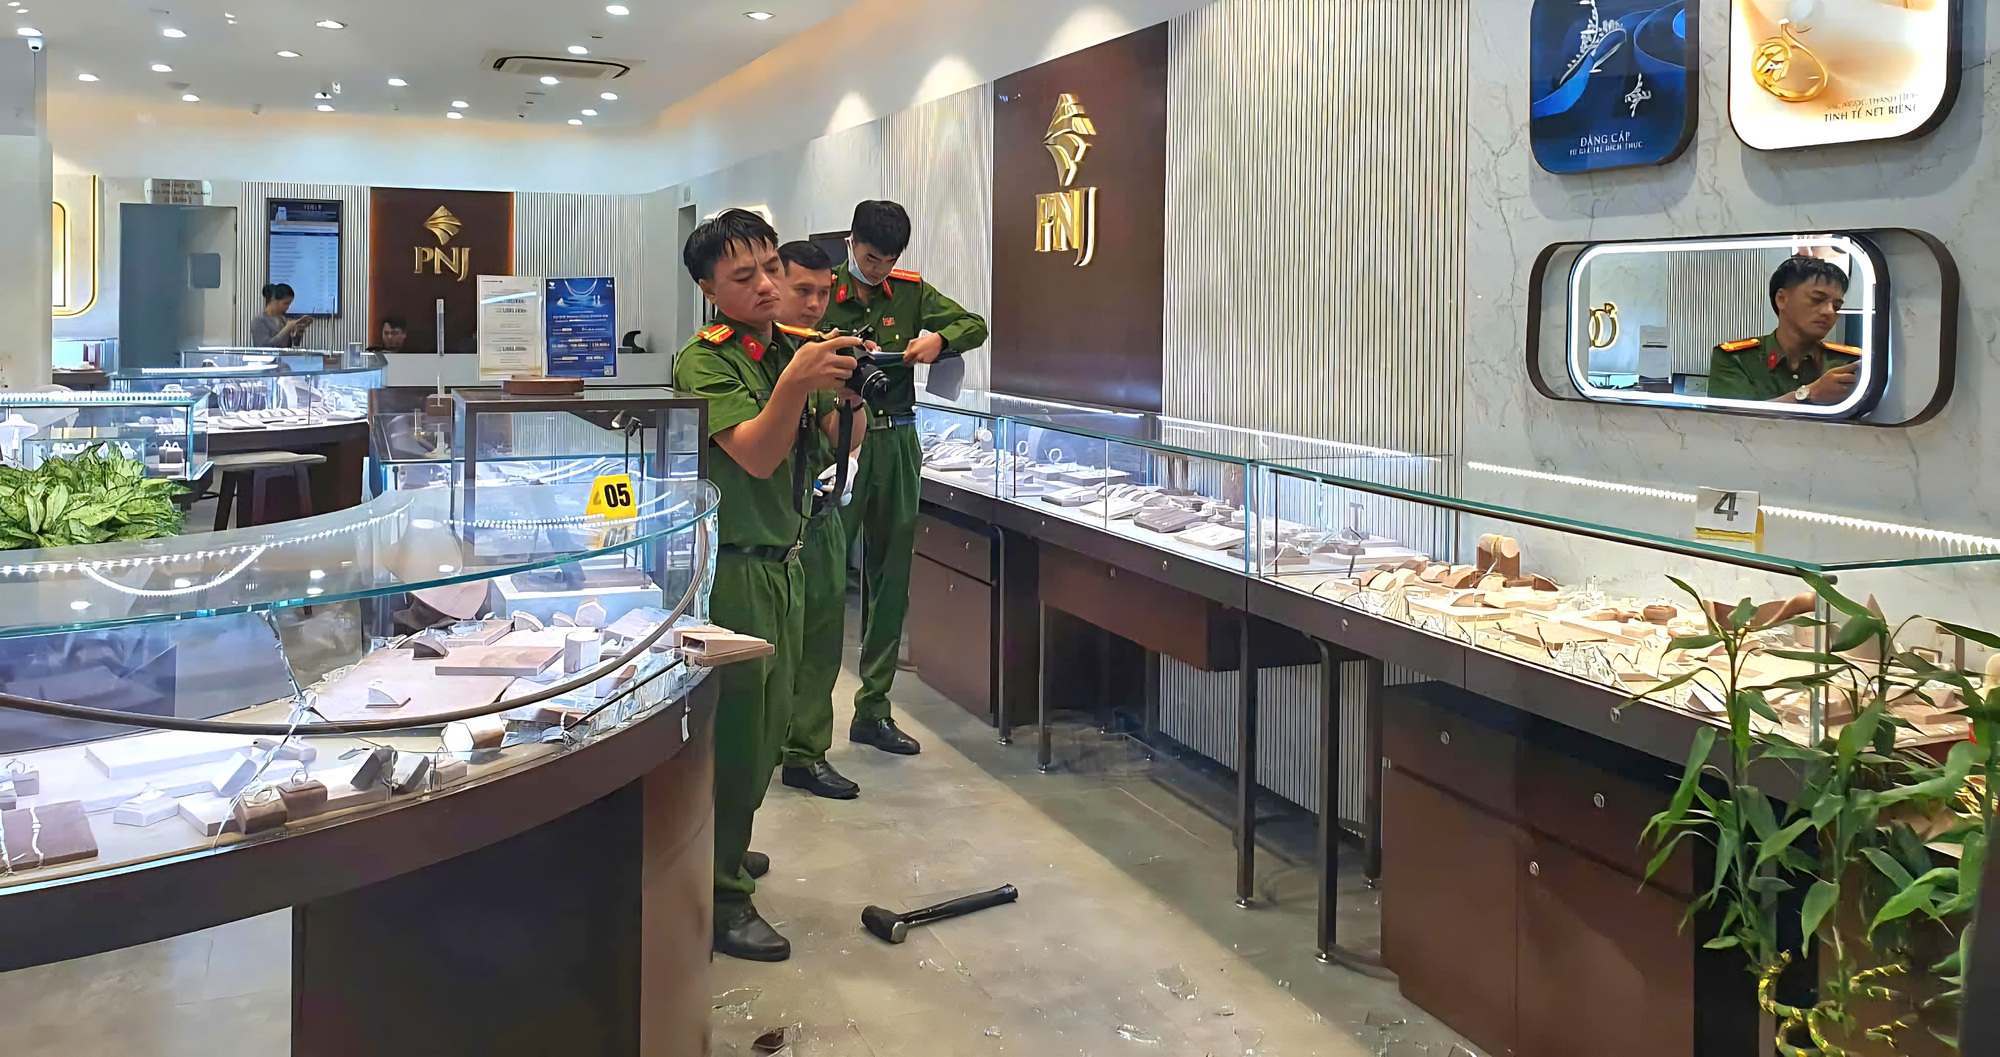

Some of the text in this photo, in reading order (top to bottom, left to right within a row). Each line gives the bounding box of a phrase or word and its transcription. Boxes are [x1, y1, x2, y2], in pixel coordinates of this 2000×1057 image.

[1034, 187, 1098, 267] PNJ
[413, 246, 471, 282] PNJ
[604, 483, 631, 508] 05
[1713, 491, 1739, 522] 4
